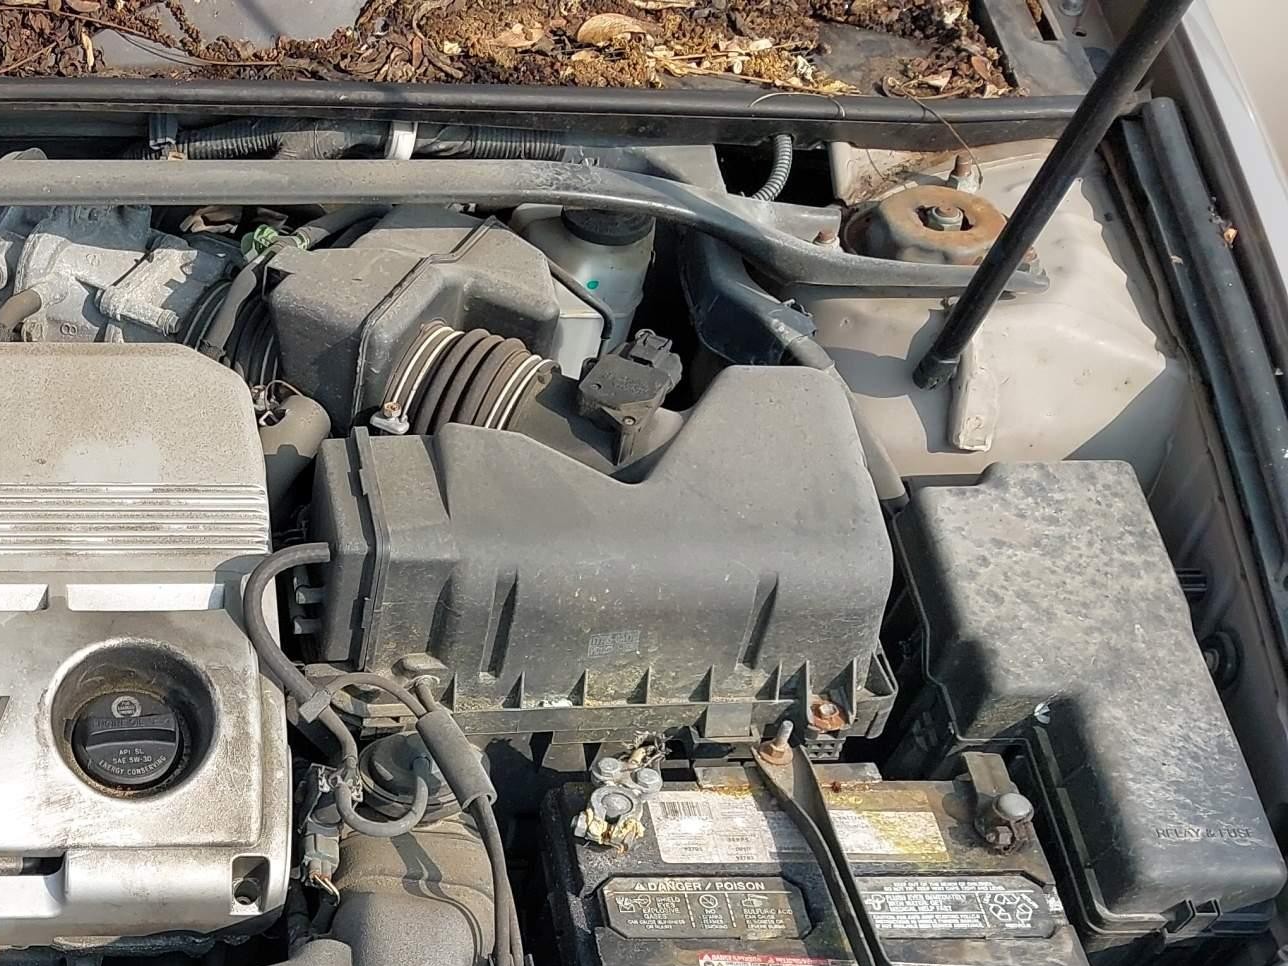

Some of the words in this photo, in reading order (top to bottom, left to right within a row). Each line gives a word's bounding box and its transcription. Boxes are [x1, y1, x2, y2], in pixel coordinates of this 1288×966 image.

[128, 755, 153, 763] 5W-30
[126, 755, 167, 776] CONSERVING
[1155, 828, 1200, 838] RELAY
[1218, 828, 1253, 838] FUSE
[648, 882, 702, 891] DANGER
[715, 881, 765, 891] POISON
